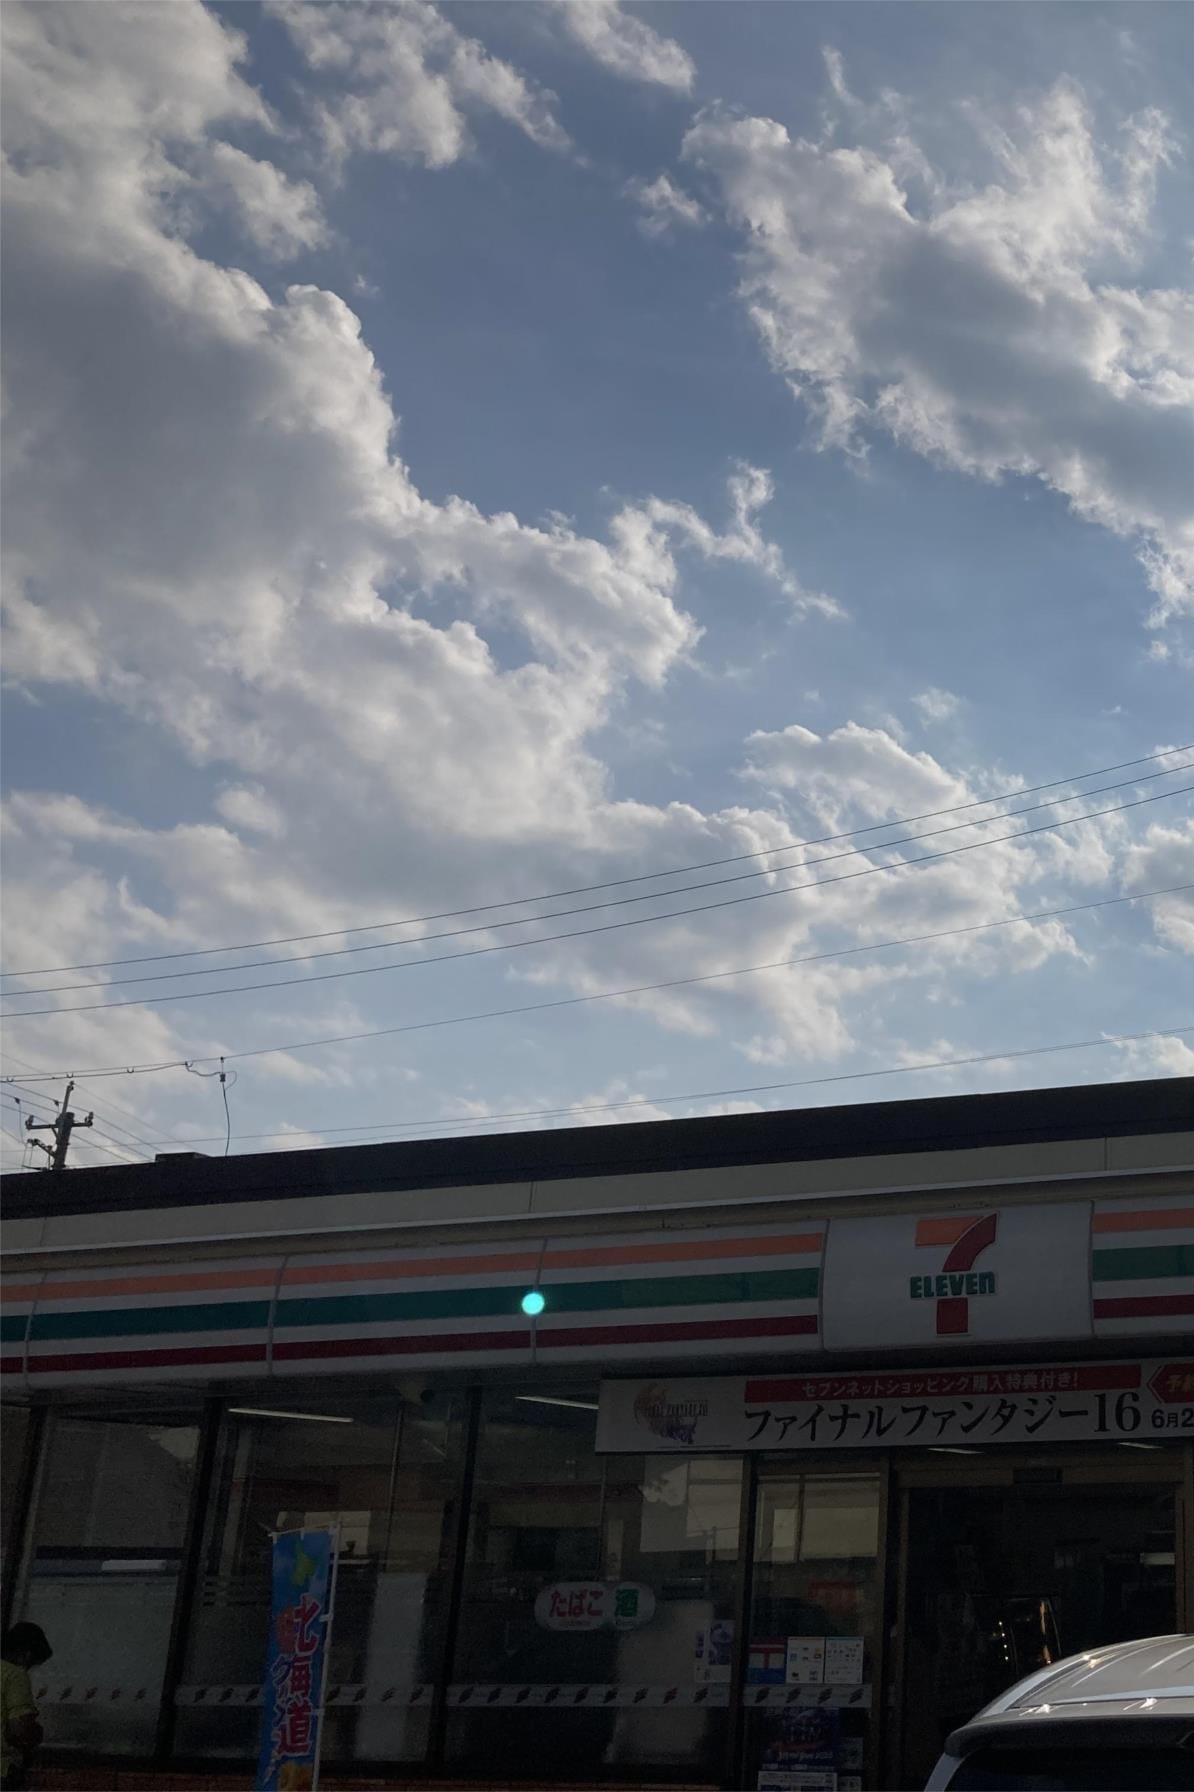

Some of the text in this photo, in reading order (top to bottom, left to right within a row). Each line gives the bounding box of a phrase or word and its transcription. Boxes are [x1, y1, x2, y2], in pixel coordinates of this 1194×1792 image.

[915, 1212, 998, 1335] 7
[801, 1371, 1079, 1397] セブンネットショッピング購入特典付き!
[743, 1391, 1141, 1442] ファイナルファンタジー16
[549, 1589, 604, 1618] たばこ
